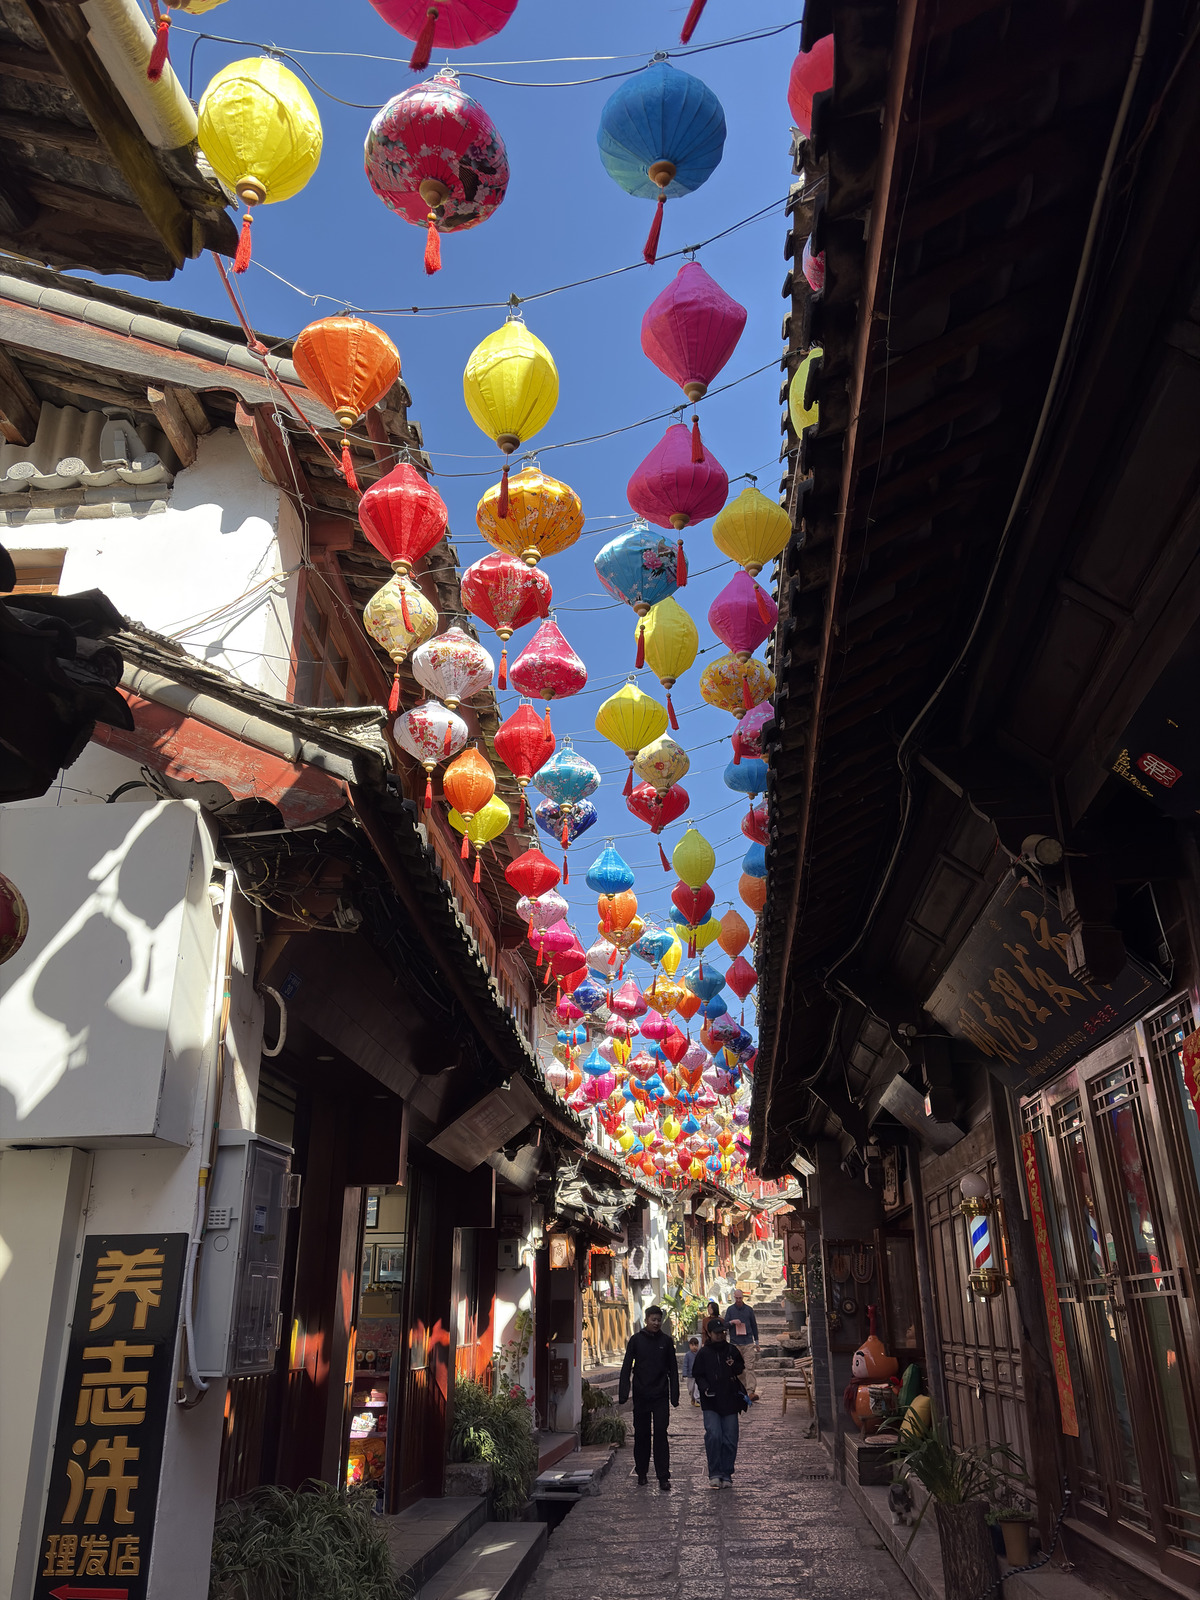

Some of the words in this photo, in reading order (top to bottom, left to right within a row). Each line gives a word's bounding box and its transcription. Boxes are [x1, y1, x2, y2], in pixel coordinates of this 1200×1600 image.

[61, 1247, 166, 1525] 养志洗
[42, 1534, 140, 1577] 理发店
